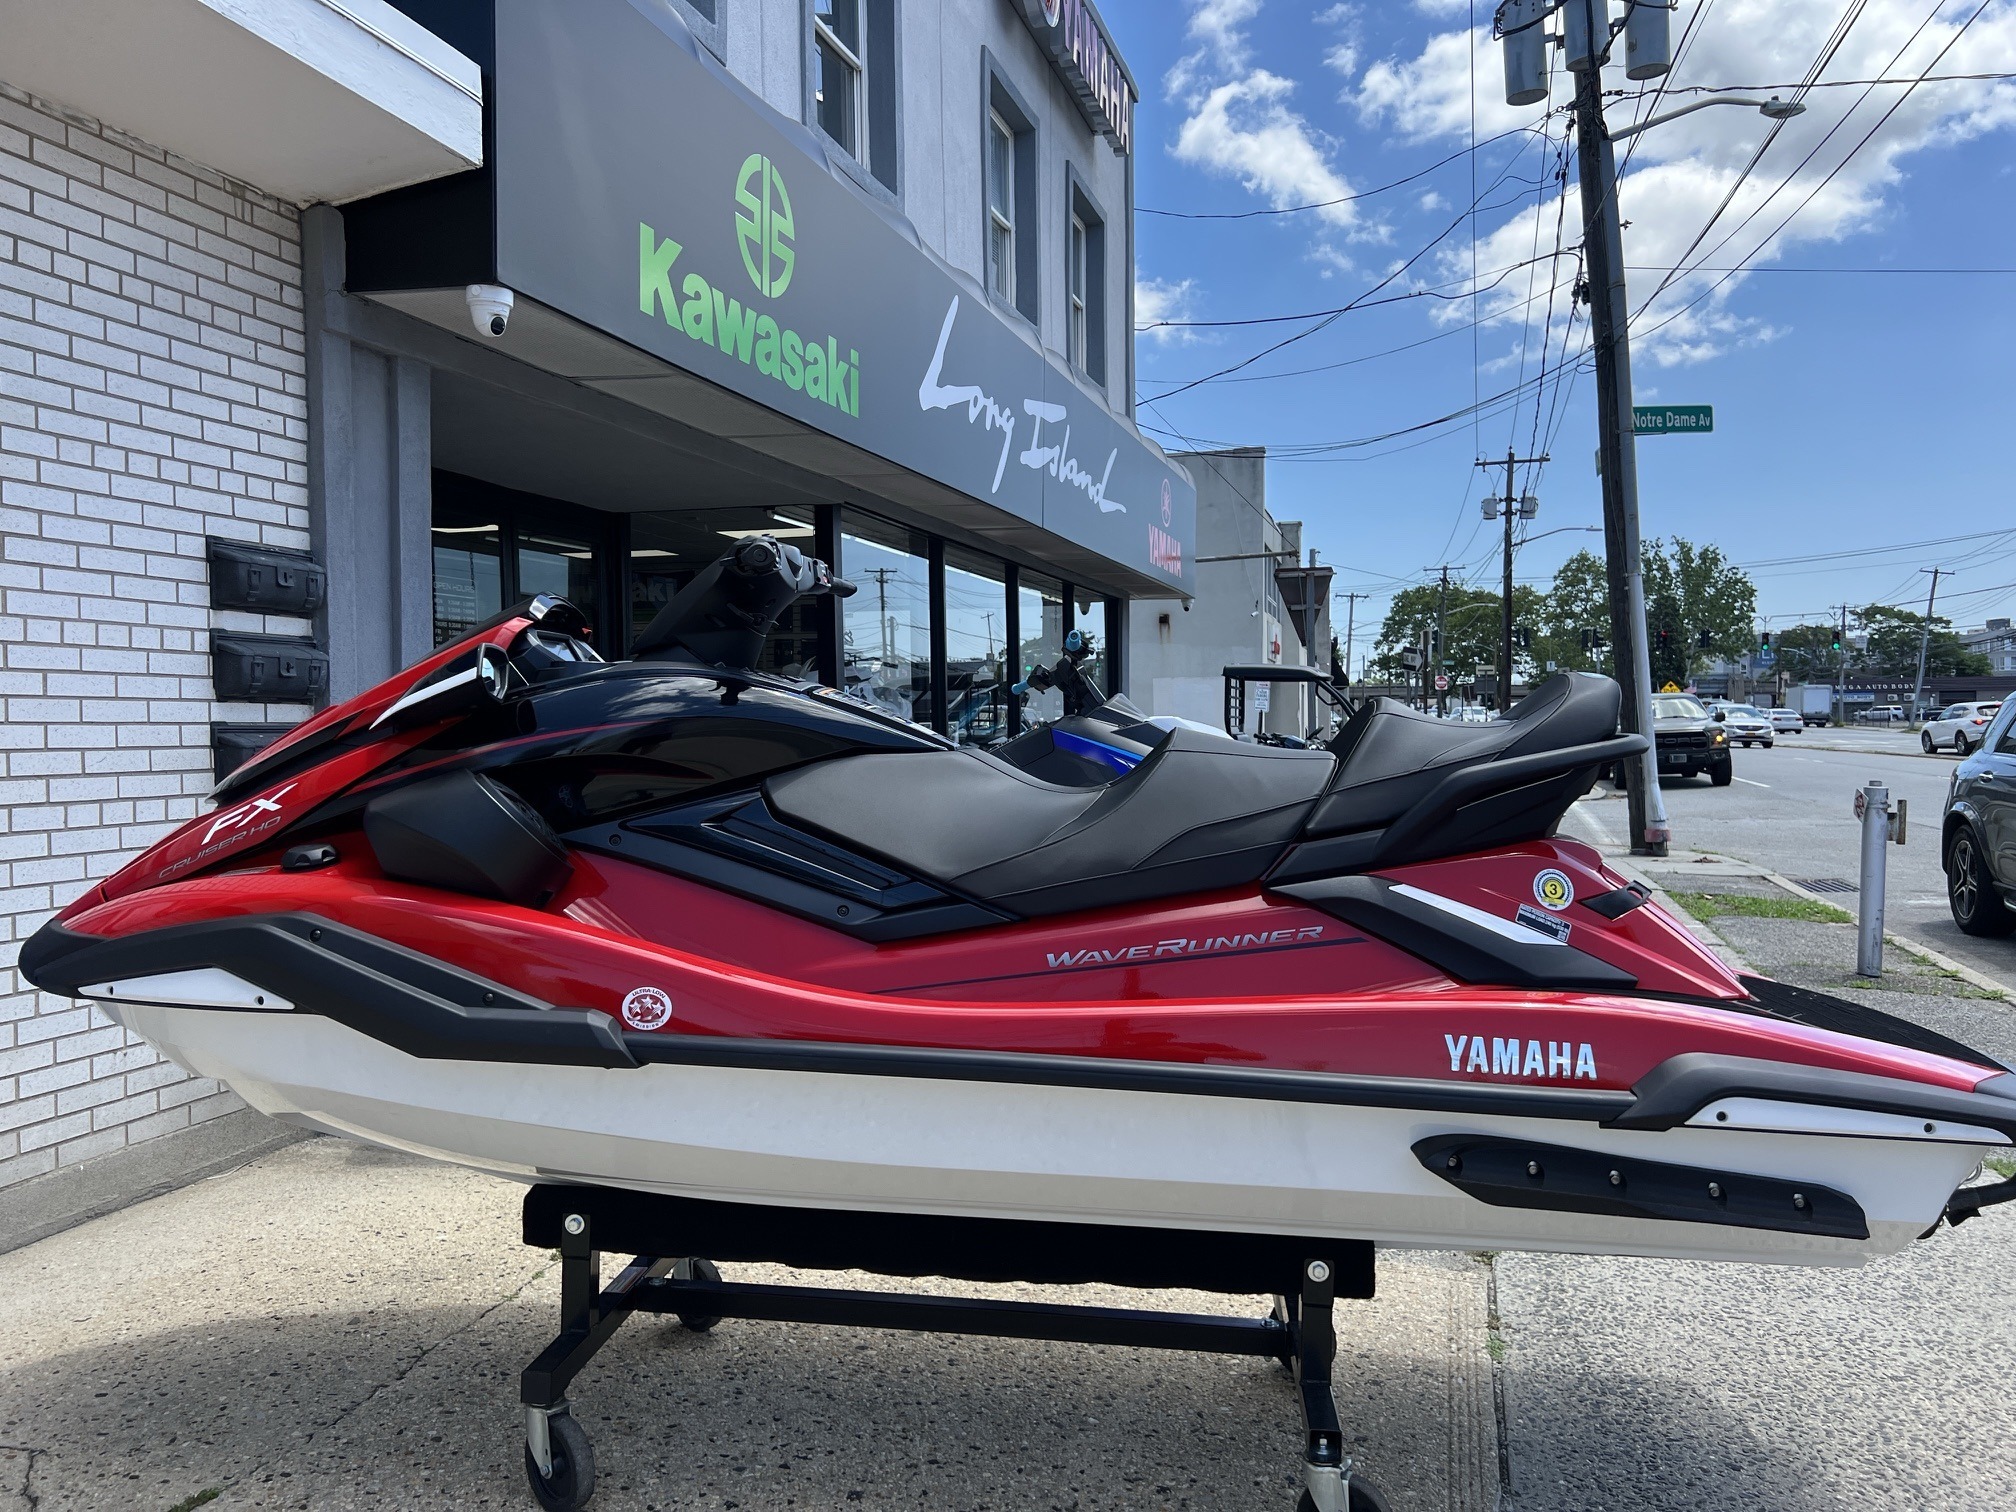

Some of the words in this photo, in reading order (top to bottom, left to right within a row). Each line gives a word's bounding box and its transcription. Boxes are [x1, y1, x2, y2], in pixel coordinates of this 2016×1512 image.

[1061, 0, 1130, 155] YAMAHA
[640, 221, 859, 418] Kawasaki
[919, 295, 1015, 493] Long
[1020, 398, 1127, 514] Island
[1632, 412, 1663, 428] Notre
[1666, 411, 1696, 427] Dame
[1699, 413, 1711, 427] Av
[1149, 523, 1182, 579] YAMAHA
[434, 582, 452, 590] OPEN
[452, 584, 475, 593] HOURS
[201, 782, 299, 846] FX
[158, 830, 247, 879] CRUISER
[1549, 883, 1558, 896] 3
[1046, 925, 1324, 968] WAVERUNNER
[1444, 1034, 1598, 1081] YAMAHA
